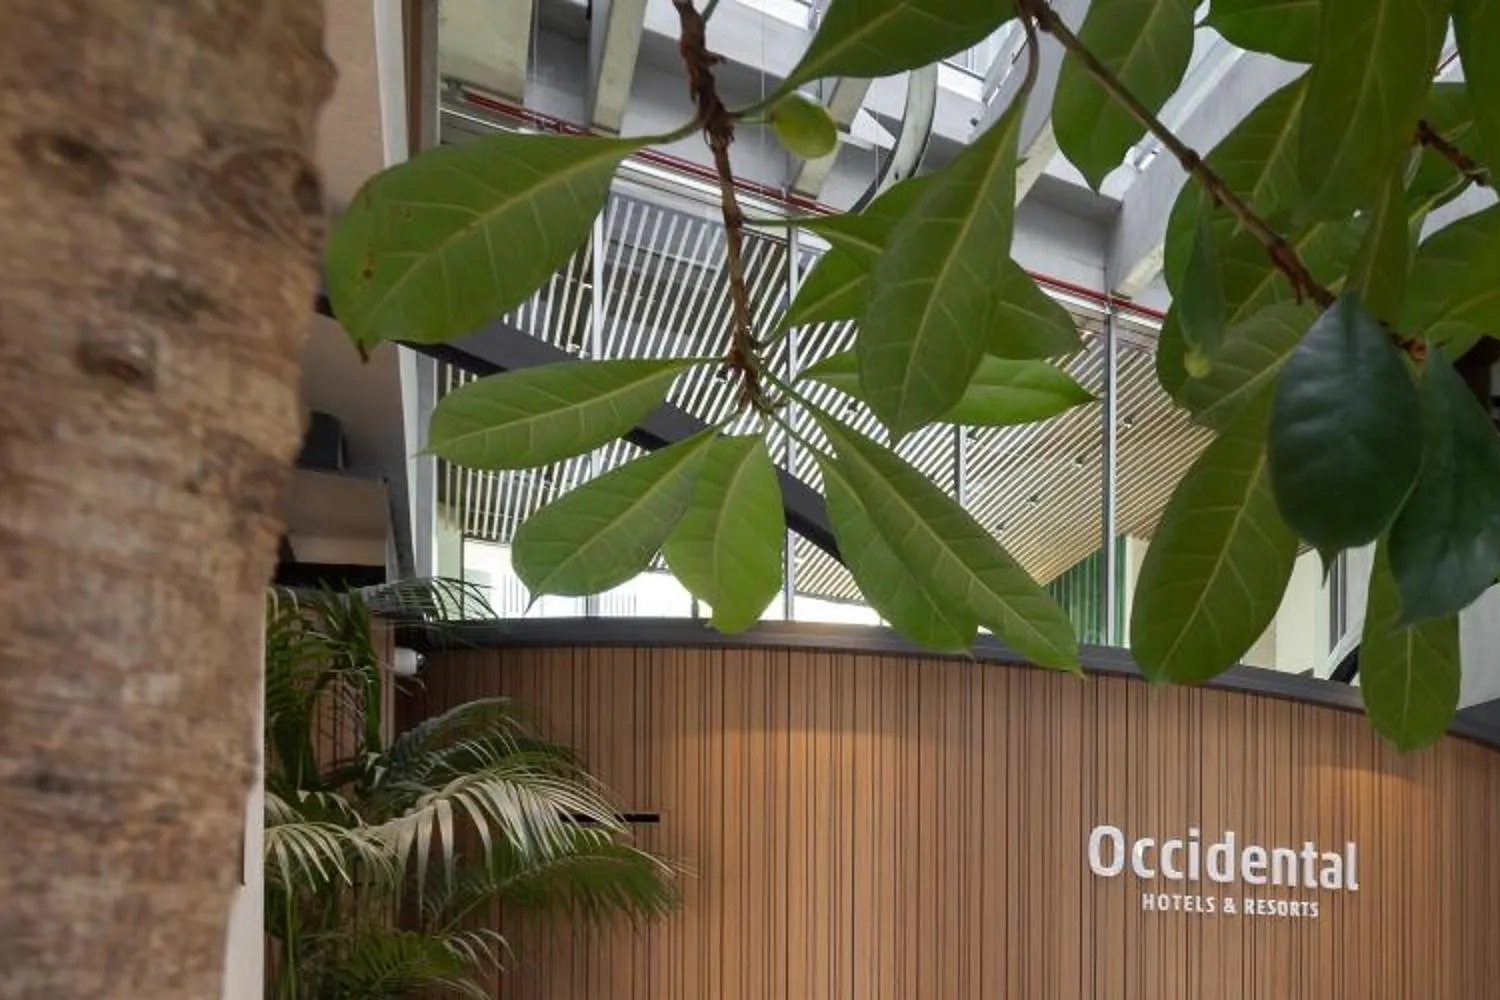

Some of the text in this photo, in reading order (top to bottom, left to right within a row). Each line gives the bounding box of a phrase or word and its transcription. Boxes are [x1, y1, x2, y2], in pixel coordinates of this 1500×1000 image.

[1088, 825, 1359, 891] Occidental
[1141, 893, 1319, 918] HOTELS & RESORTS
